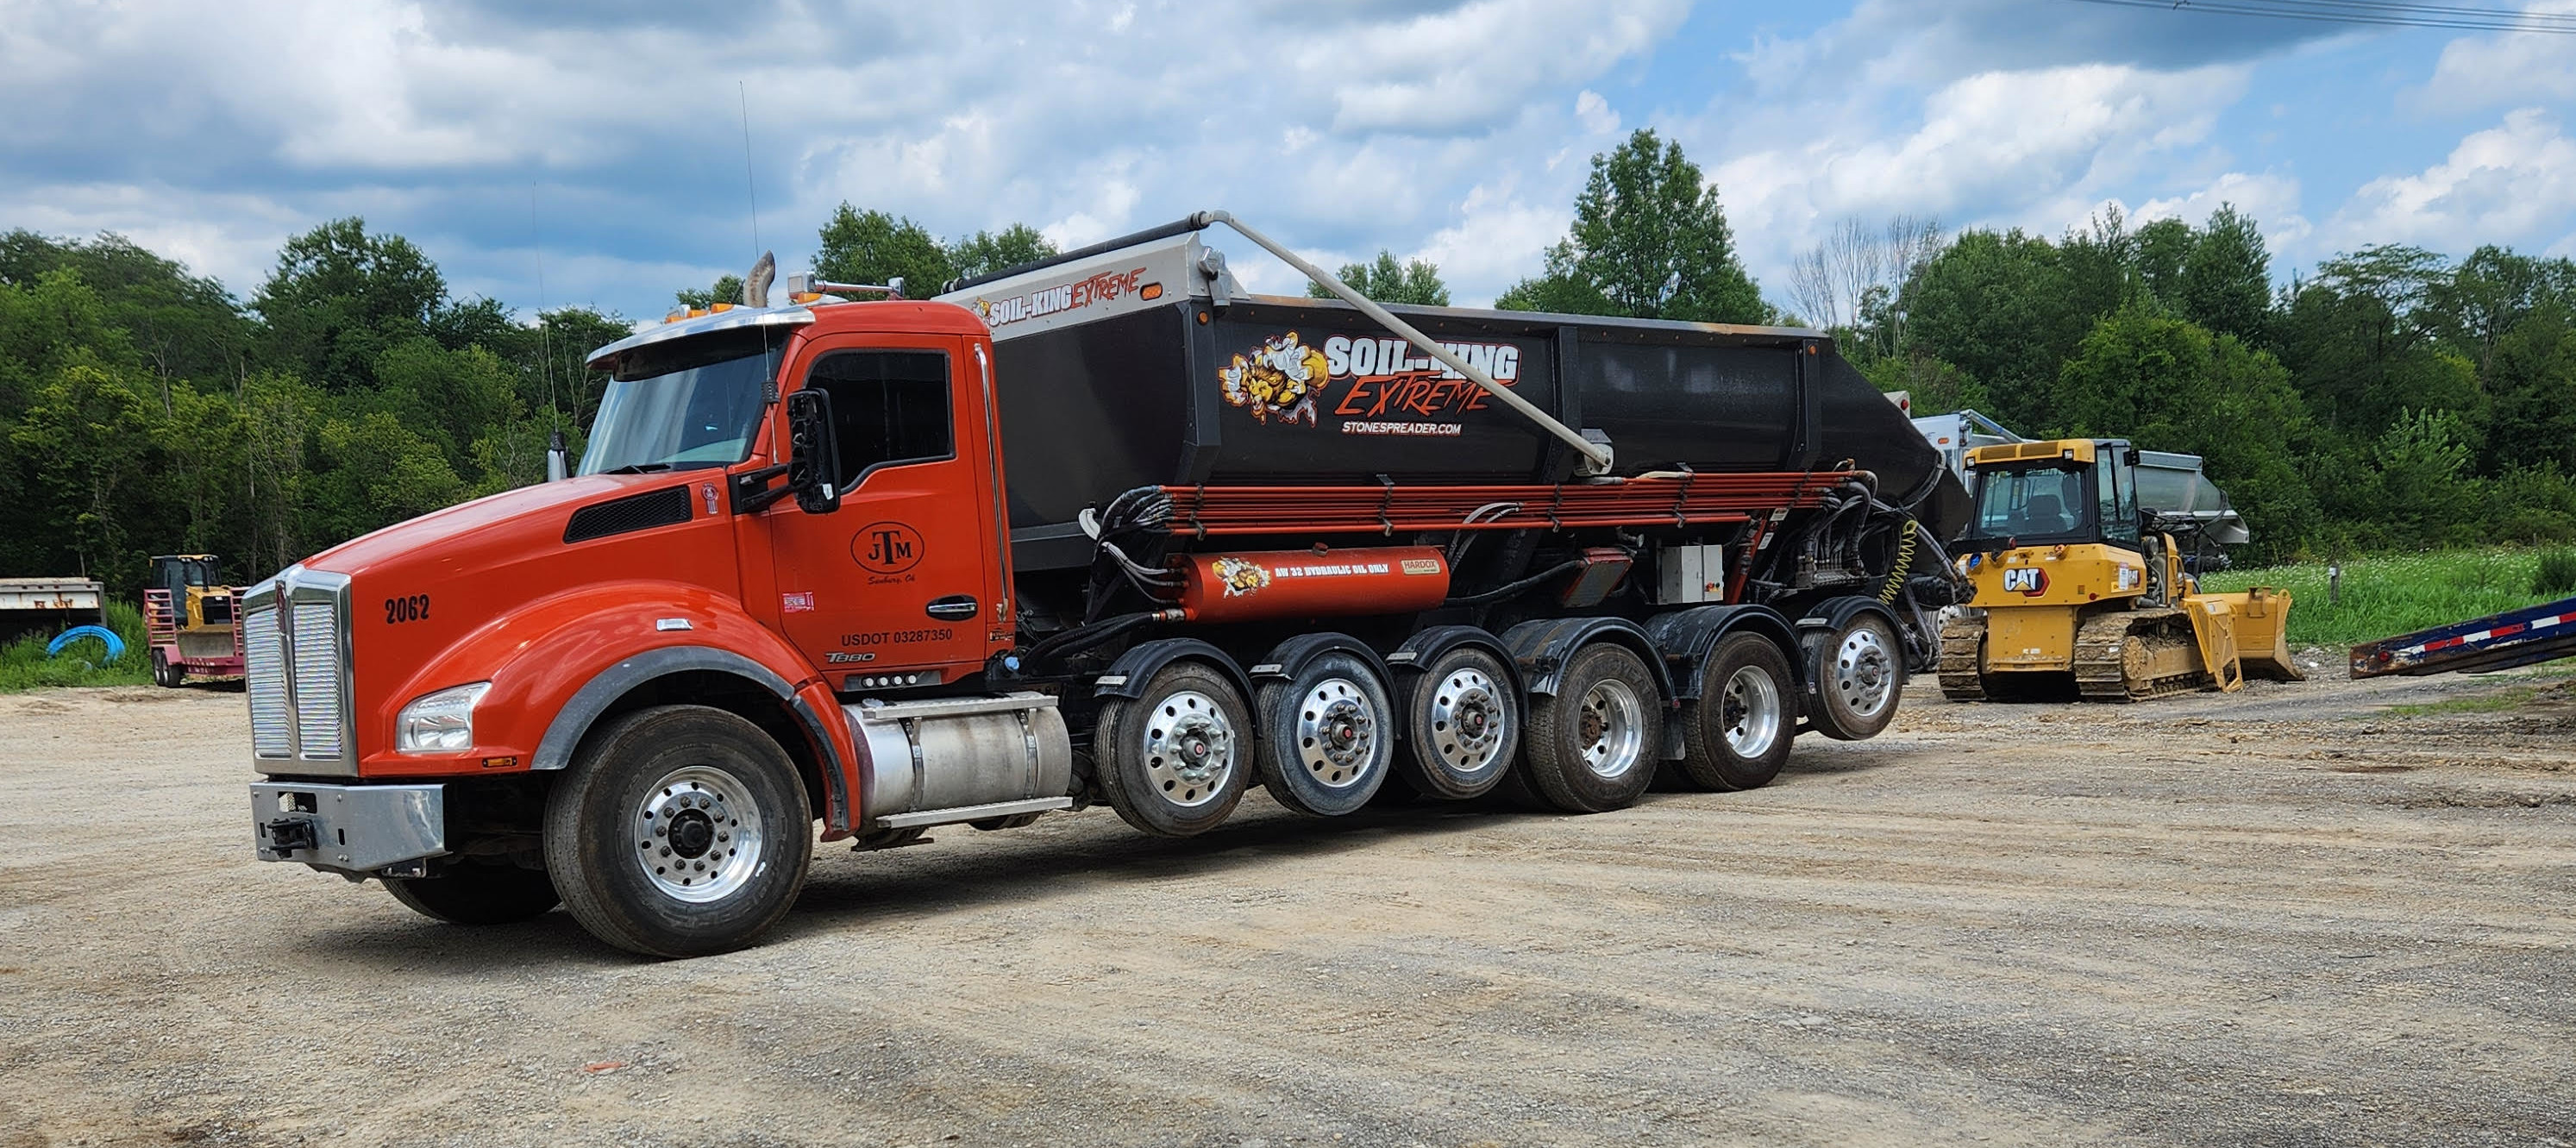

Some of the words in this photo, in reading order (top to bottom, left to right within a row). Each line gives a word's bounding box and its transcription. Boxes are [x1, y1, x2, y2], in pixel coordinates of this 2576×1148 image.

[989, 285, 1073, 327] SOIL-KING
[1071, 267, 1147, 309] EXTREME
[1334, 371, 1514, 418] EXTREME
[1342, 421, 1462, 436] STONESPREADER.COM
[1275, 568, 1289, 578] AW
[1291, 567, 1304, 577] 32
[1304, 564, 1352, 576] HYDRAULIC
[1353, 563, 1367, 574] OIL
[1368, 563, 1389, 574] ONLY
[1404, 561, 1436, 569] HARDOX
[2004, 568, 2040, 592] CAT
[385, 594, 429, 624] 2062
[842, 632, 891, 646] USDOT
[893, 629, 953, 644] 03287350
[825, 652, 876, 663] T880
